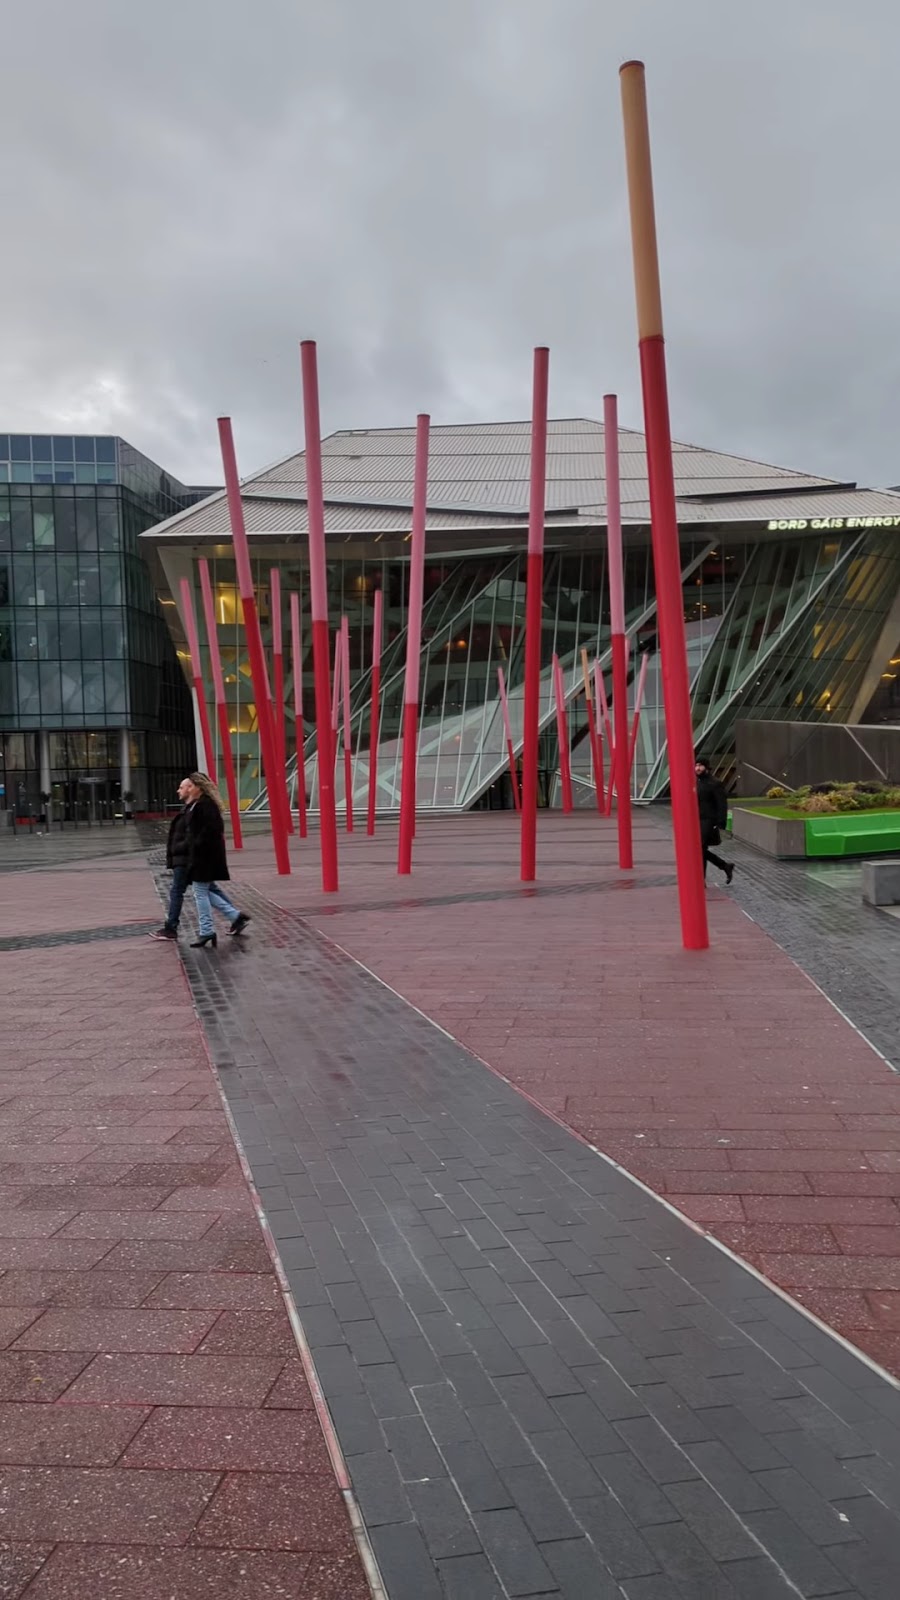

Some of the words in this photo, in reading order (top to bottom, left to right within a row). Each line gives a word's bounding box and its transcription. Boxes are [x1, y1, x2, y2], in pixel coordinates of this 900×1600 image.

[767, 520, 808, 530] BORD
[811, 518, 844, 529] GÁIS
[846, 516, 900, 528] ENERGY
